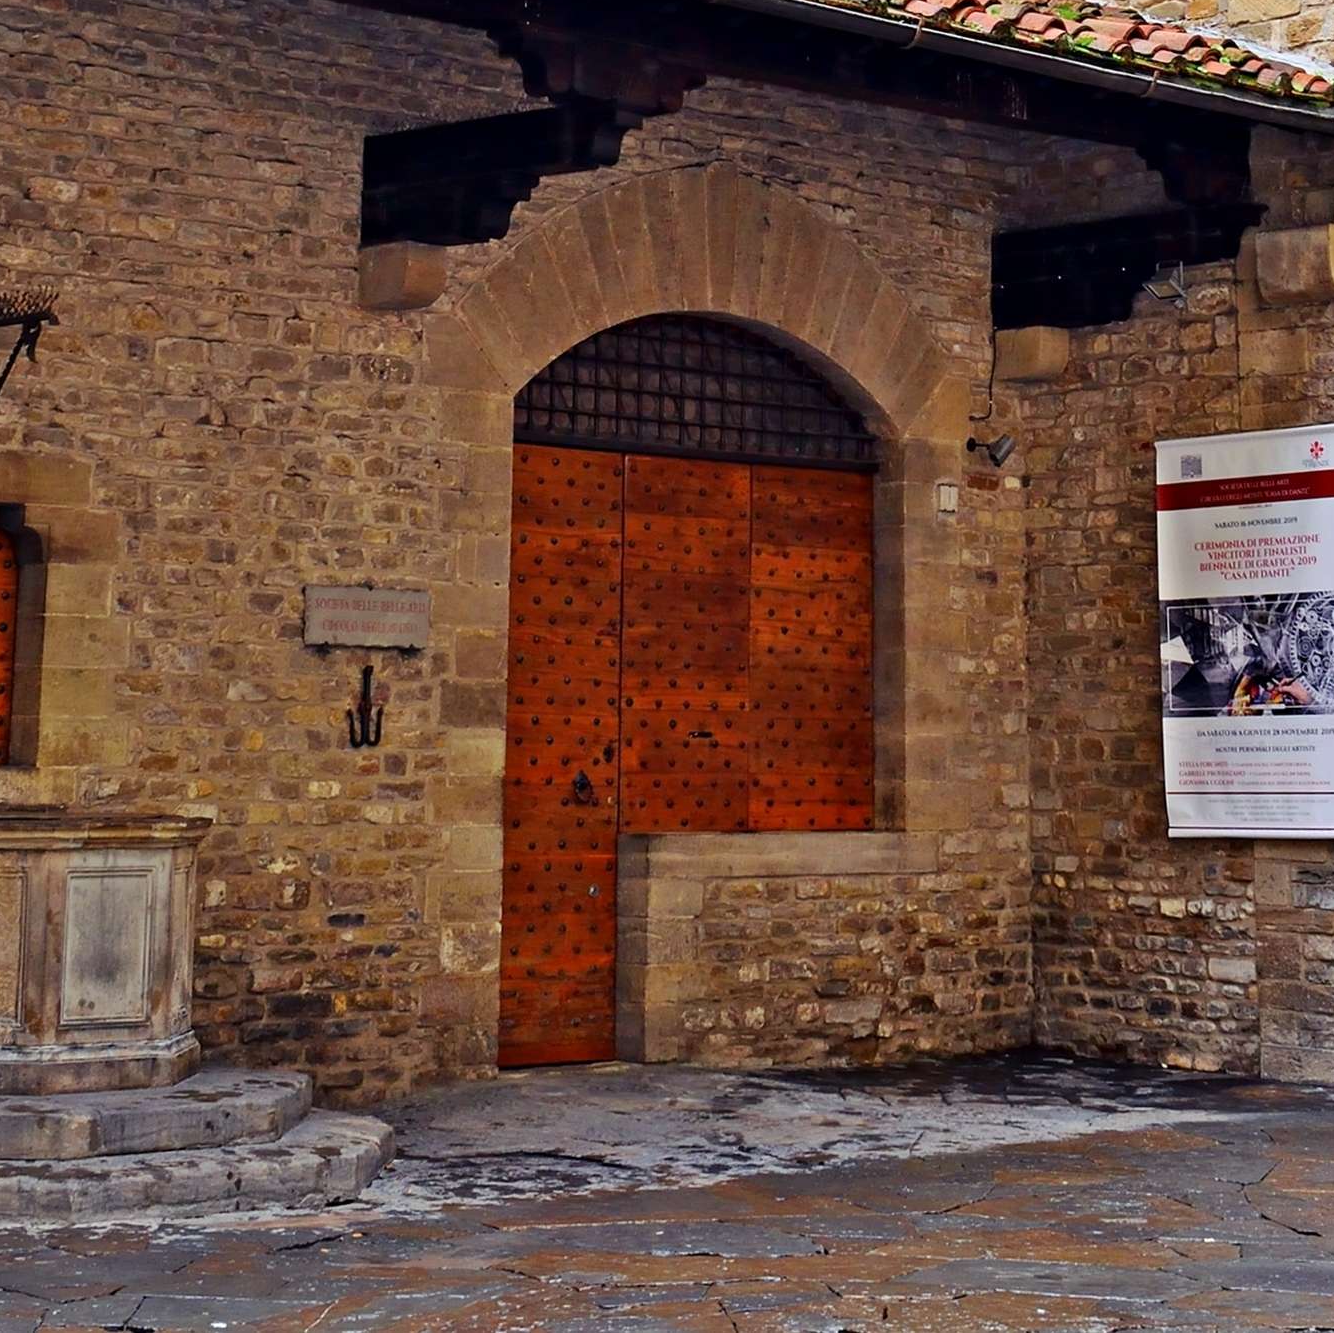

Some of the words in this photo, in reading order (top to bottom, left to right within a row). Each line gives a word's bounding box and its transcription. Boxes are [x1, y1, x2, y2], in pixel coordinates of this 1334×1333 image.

[1214, 521, 1240, 529] SABATO
[1246, 518, 1282, 527] NOVEMBRE
[1283, 516, 1298, 524] 2019
[1194, 539, 1245, 552] CERIMONIA
[1247, 538, 1257, 548] DI
[1258, 534, 1321, 547] PREMIAZIONE
[1208, 549, 1255, 560] VINCITORI
[1256, 549, 1262, 558] E
[1263, 546, 1307, 558] FINALISTI
[1199, 561, 1242, 572] BIENNALE
[1244, 560, 1255, 569] DI
[1256, 557, 1296, 569] GRAFICA
[1297, 555, 1317, 566] 2019
[1249, 570, 1259, 579] DI
[1281, 728, 1318, 736] NOVEMBRE
